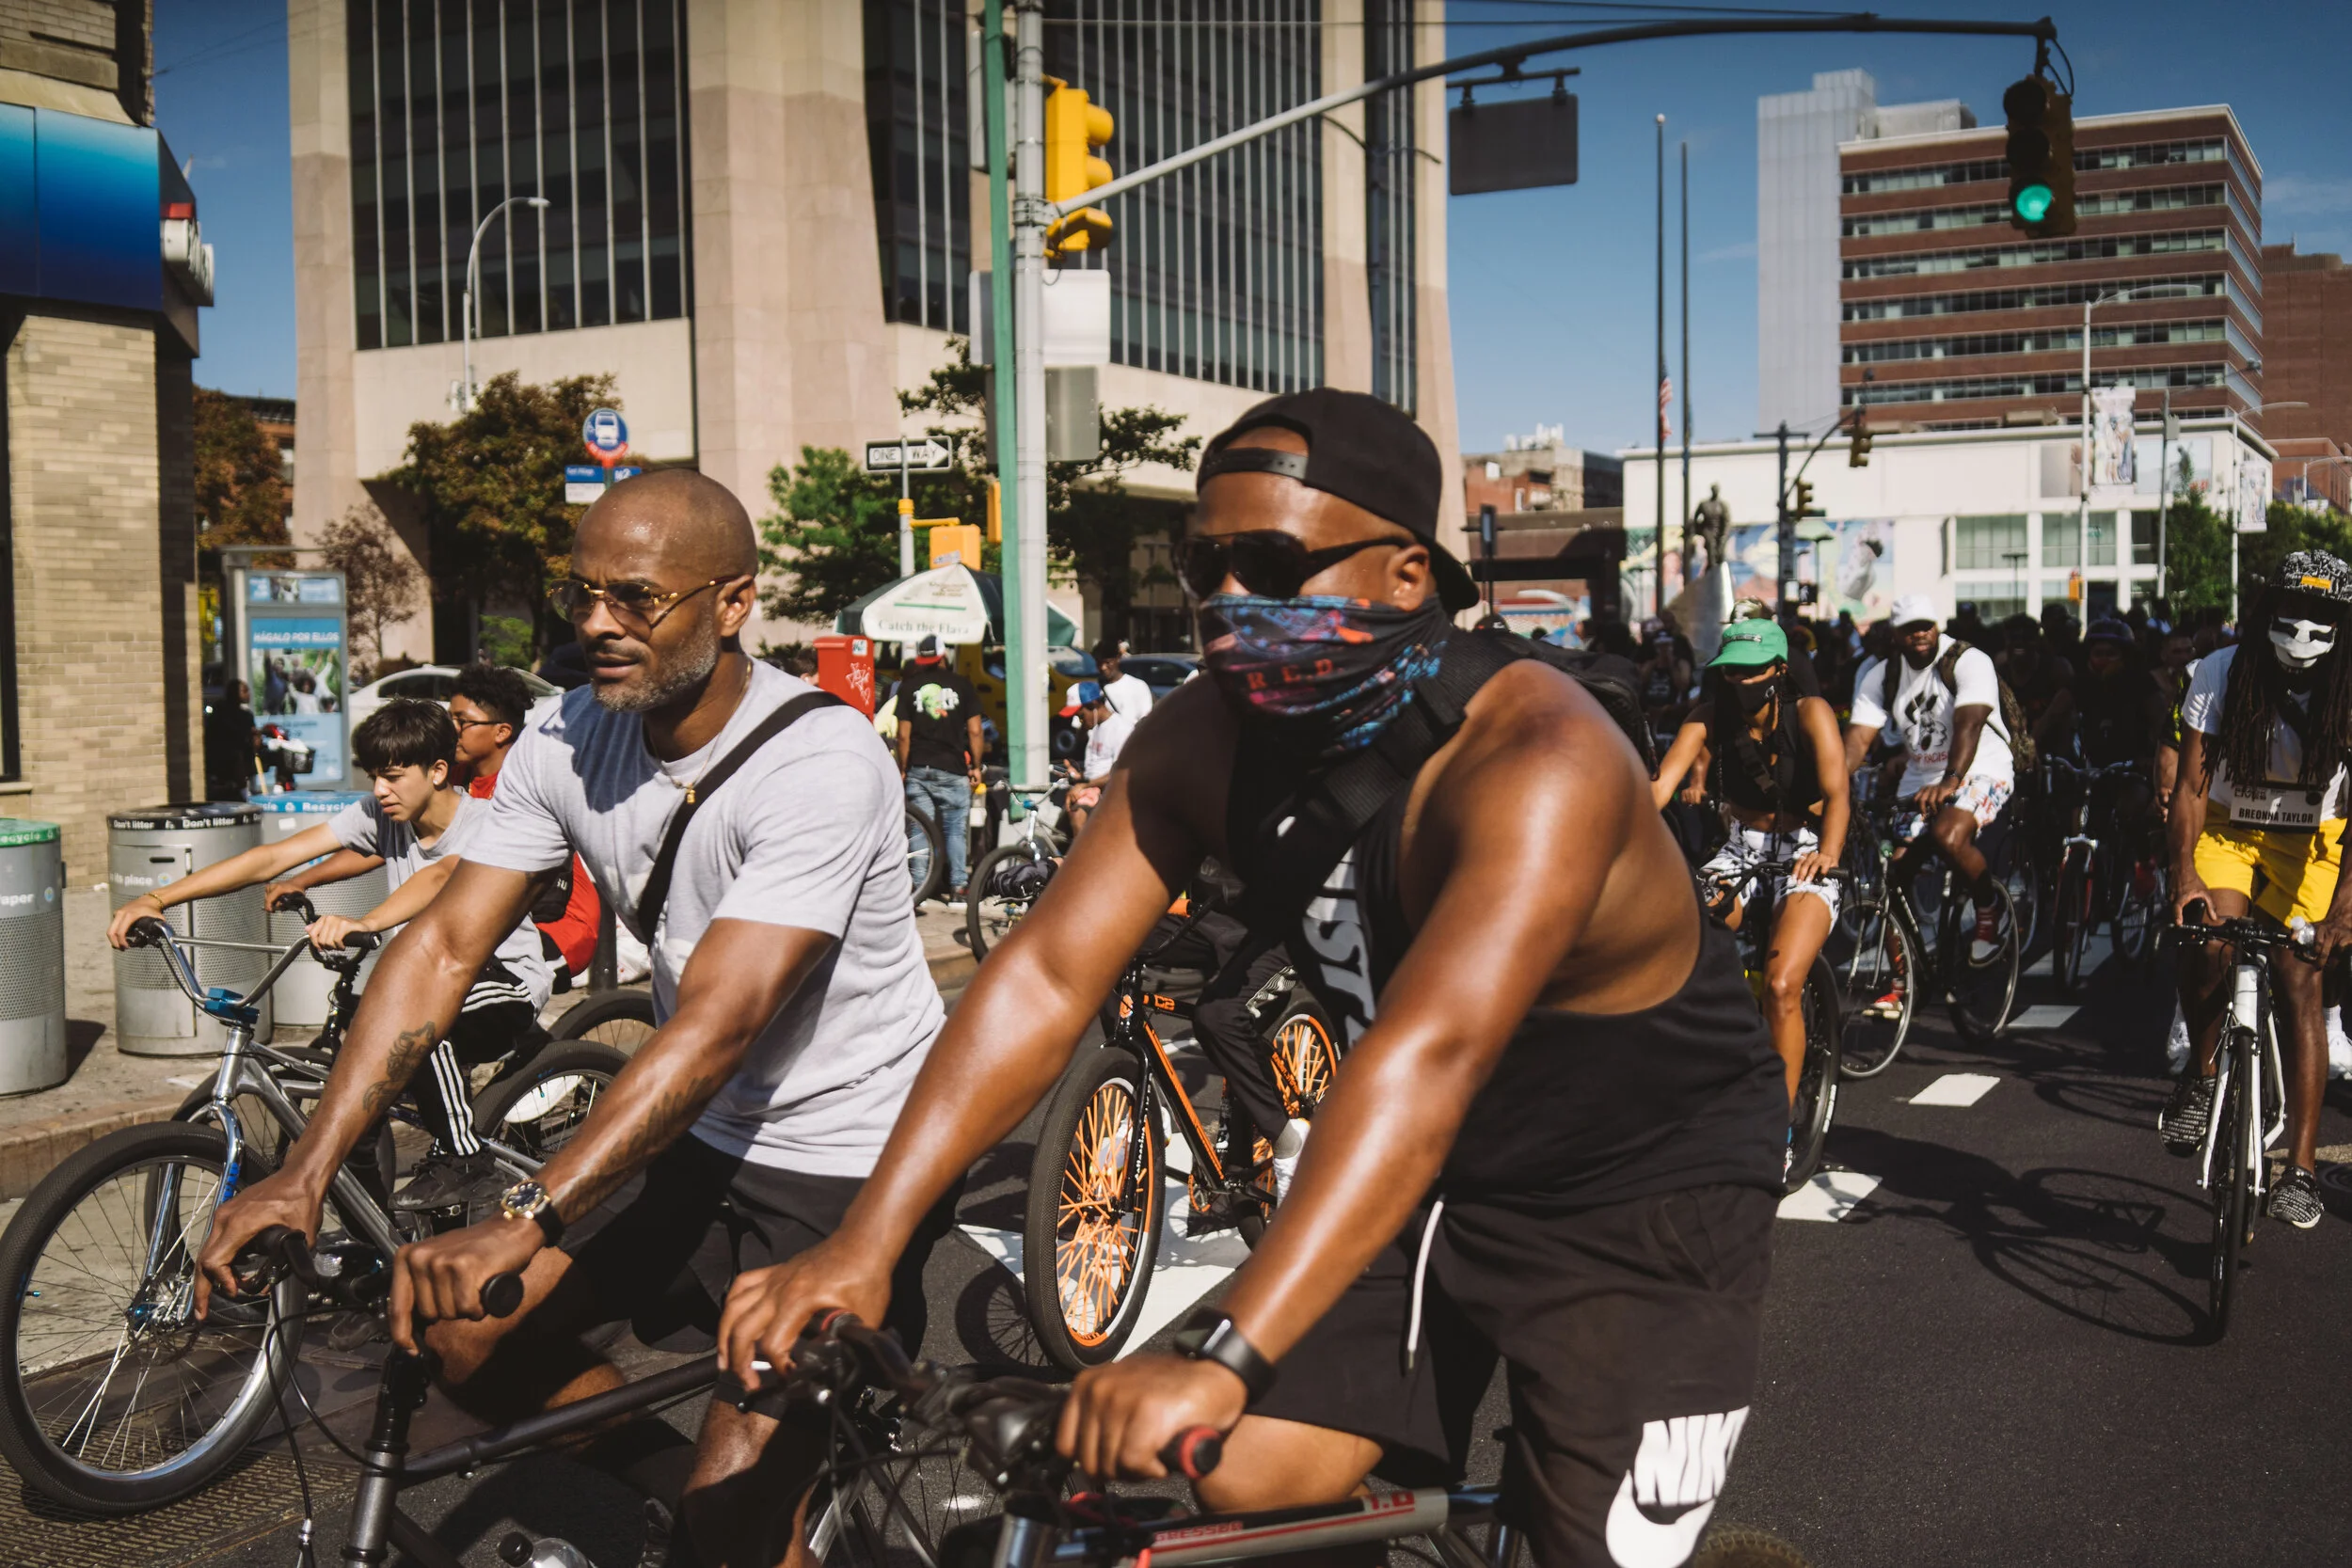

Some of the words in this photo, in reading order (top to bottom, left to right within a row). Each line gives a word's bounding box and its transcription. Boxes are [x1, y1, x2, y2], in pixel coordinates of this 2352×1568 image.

[872, 448, 897, 461] ONE
[910, 447, 938, 460] WAY
[878, 619, 913, 632] Catch
[916, 622, 935, 633] the
[292, 631, 310, 643] POR
[311, 631, 340, 643] ELLOS
[183, 818, 212, 829] Don't
[213, 816, 235, 826] litter
[2239, 808, 2279, 822] BREONNA
[2281, 812, 2313, 823] TAYLOR
[114, 819, 132, 829] Don't
[132, 820, 155, 830] litter
[0, 831, 40, 845] ecycle
[124, 874, 153, 887] place
[0, 893, 35, 907] aper
[1633, 1405, 1750, 1507] NIK
[1153, 1520, 1244, 1543] GRESSOR
